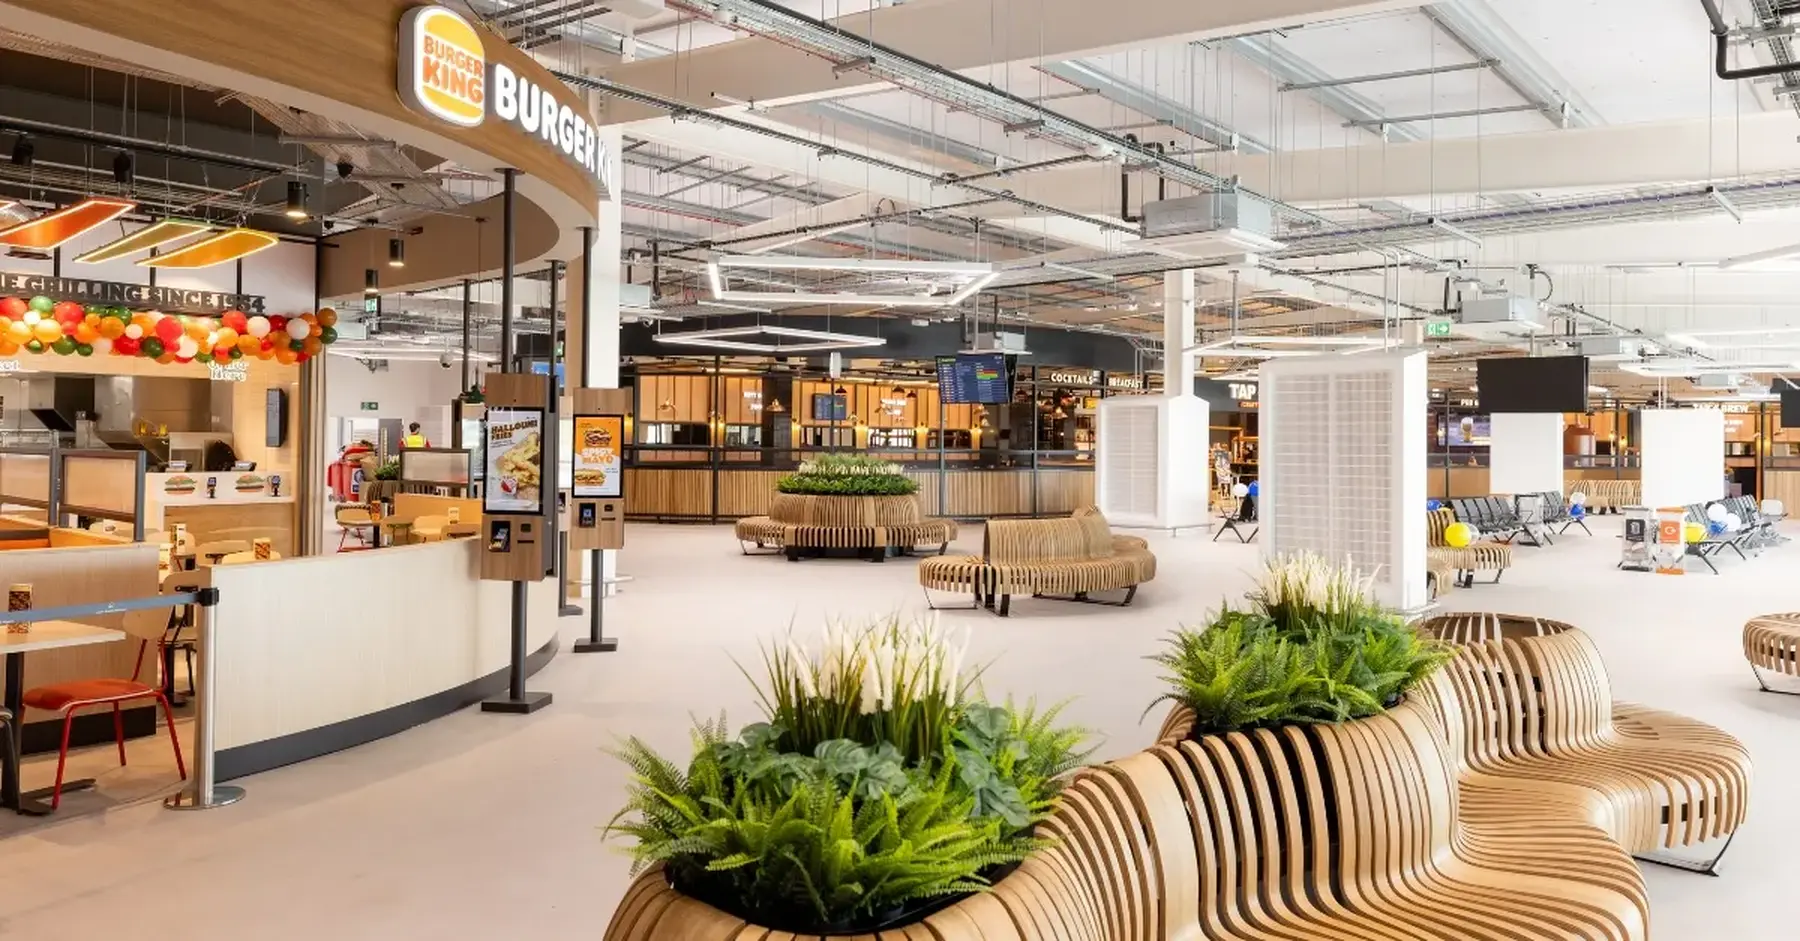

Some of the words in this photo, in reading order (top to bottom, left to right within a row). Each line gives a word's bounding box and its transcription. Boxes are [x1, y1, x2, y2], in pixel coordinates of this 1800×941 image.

[424, 35, 483, 79] BURGER
[423, 56, 483, 103] KING
[495, 62, 595, 173] BURGER
[25, 275, 141, 302] GRILLING
[148, 286, 213, 308] SINCE
[1050, 372, 1093, 385] COCKTAILS
[1108, 376, 1144, 389] BREAKFAST
[1228, 383, 1257, 400] TAP
